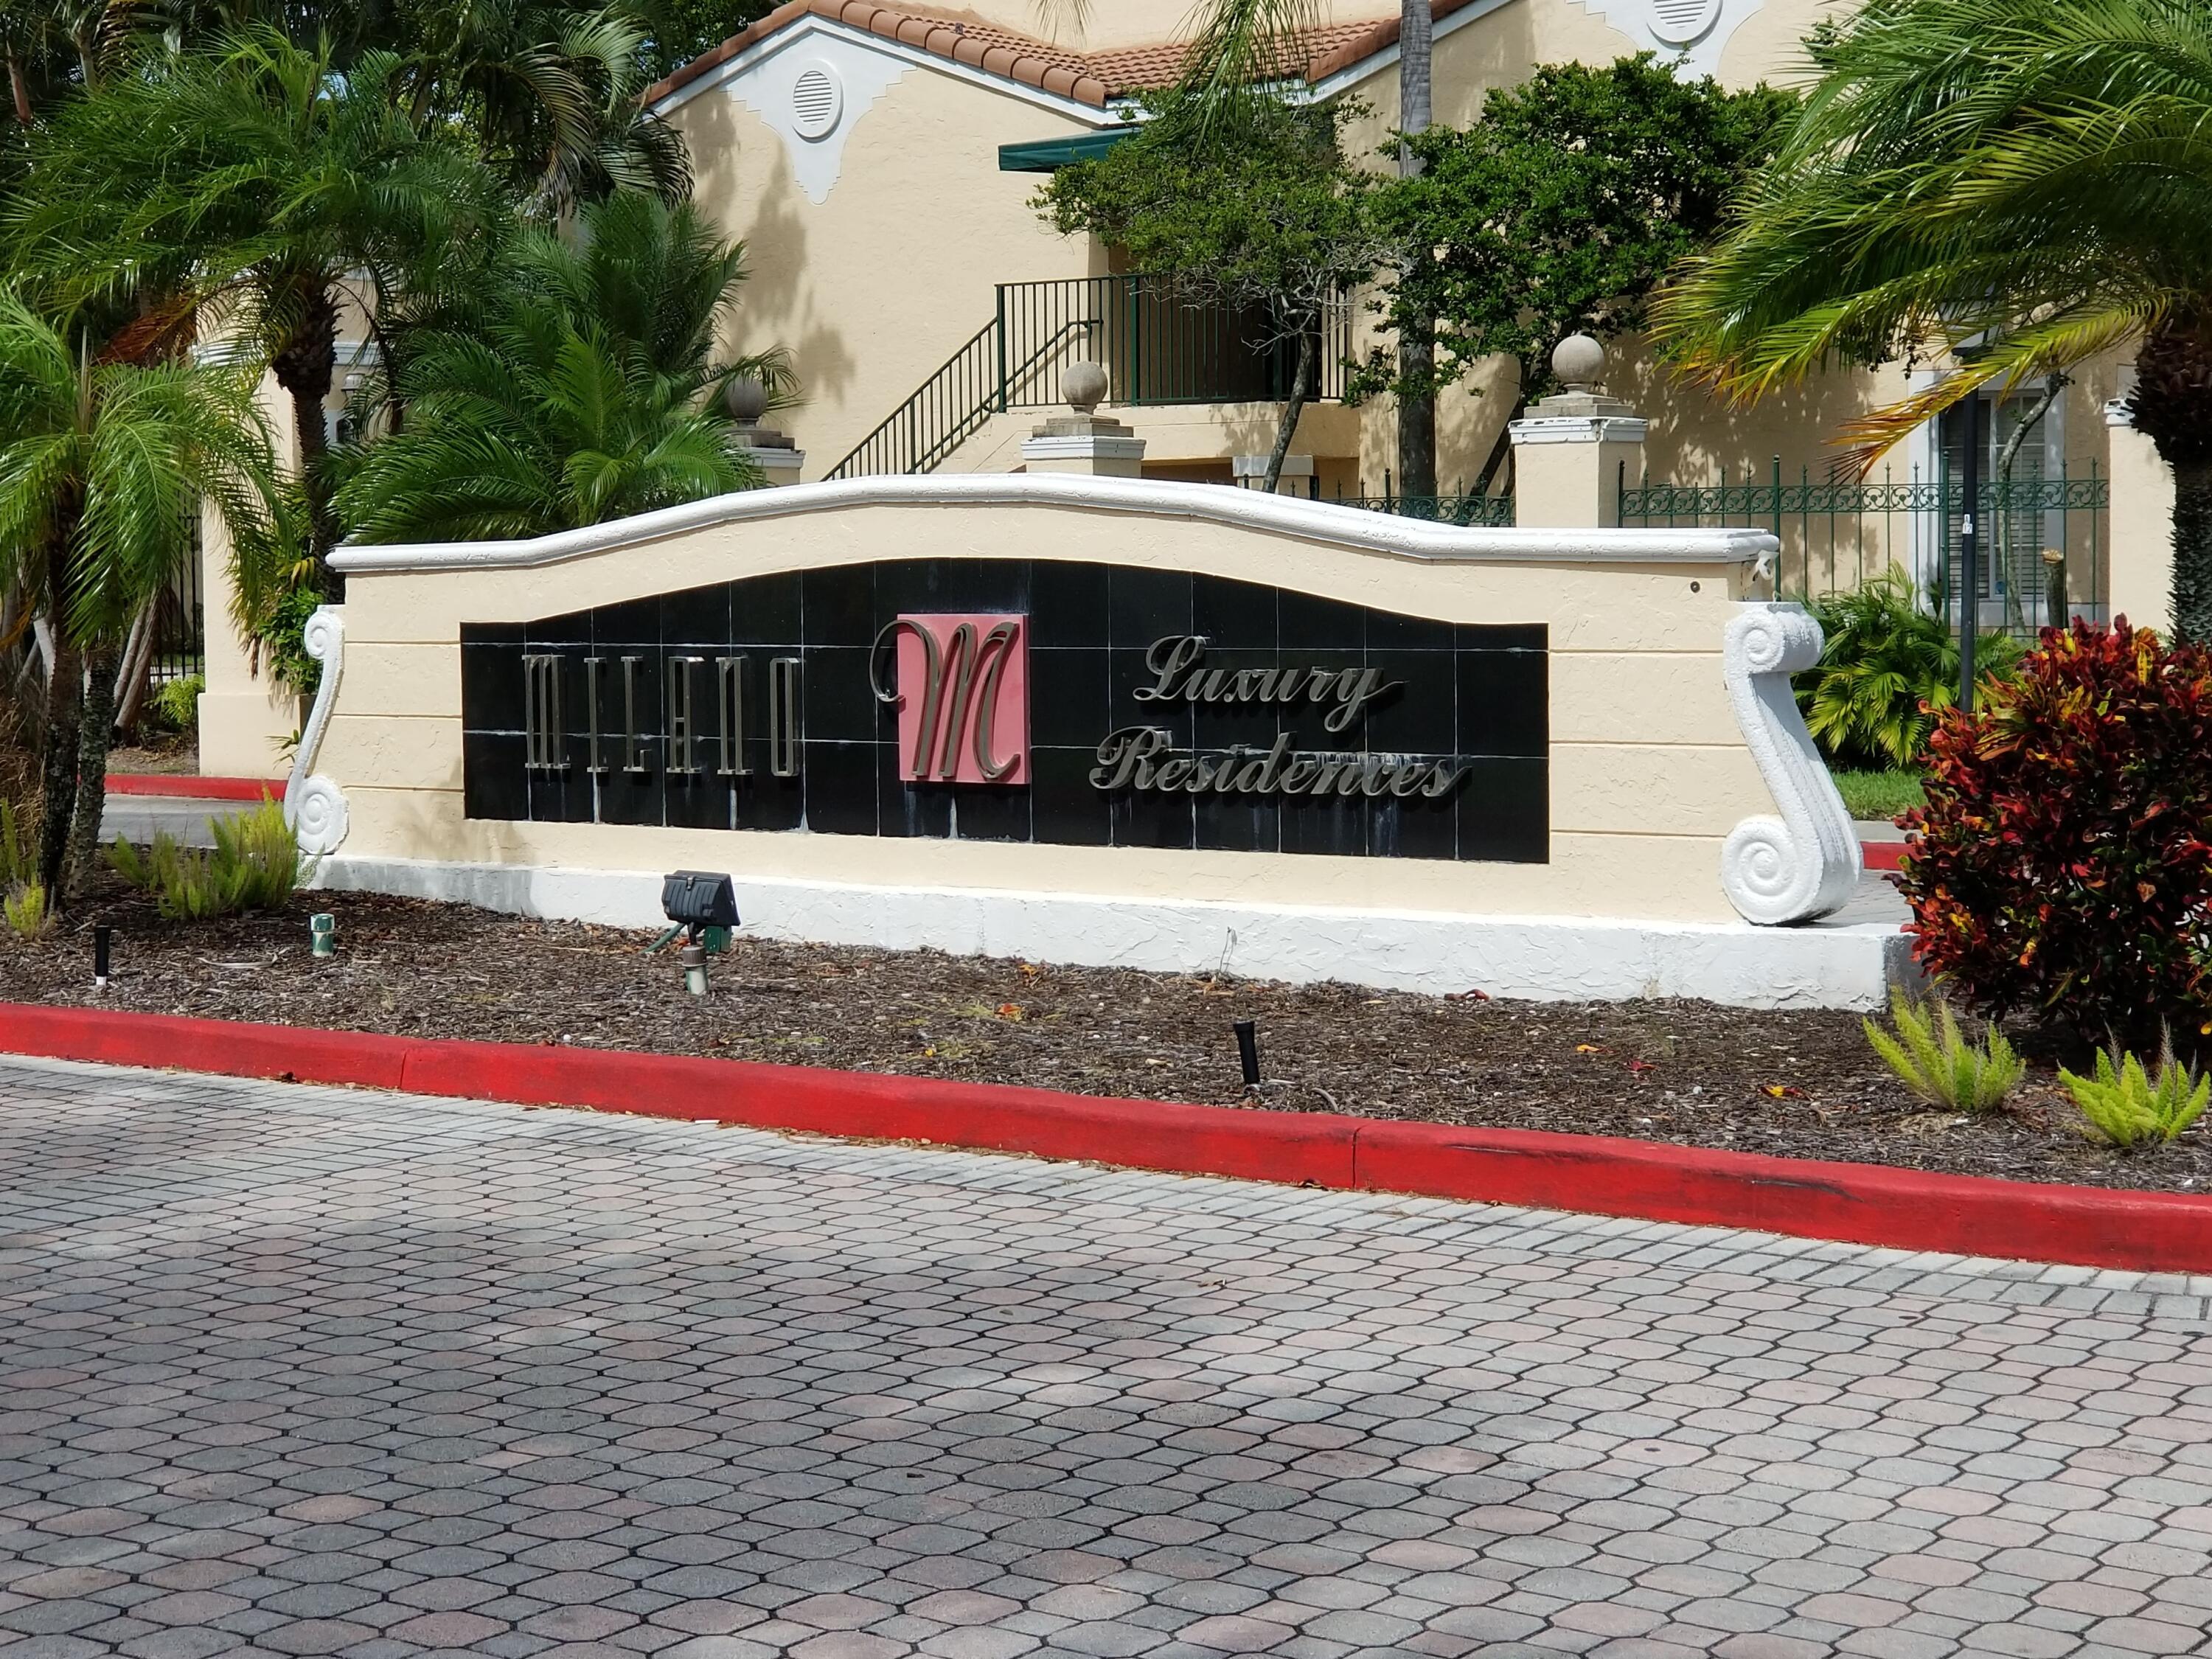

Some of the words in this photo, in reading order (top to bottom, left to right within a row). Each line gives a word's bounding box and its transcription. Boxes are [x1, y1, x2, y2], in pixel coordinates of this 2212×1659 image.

[521, 654, 802, 777] MILANO
[869, 619, 1020, 779] M
[1133, 636, 1407, 732] Luxury
[1089, 726, 1473, 796] Residences
